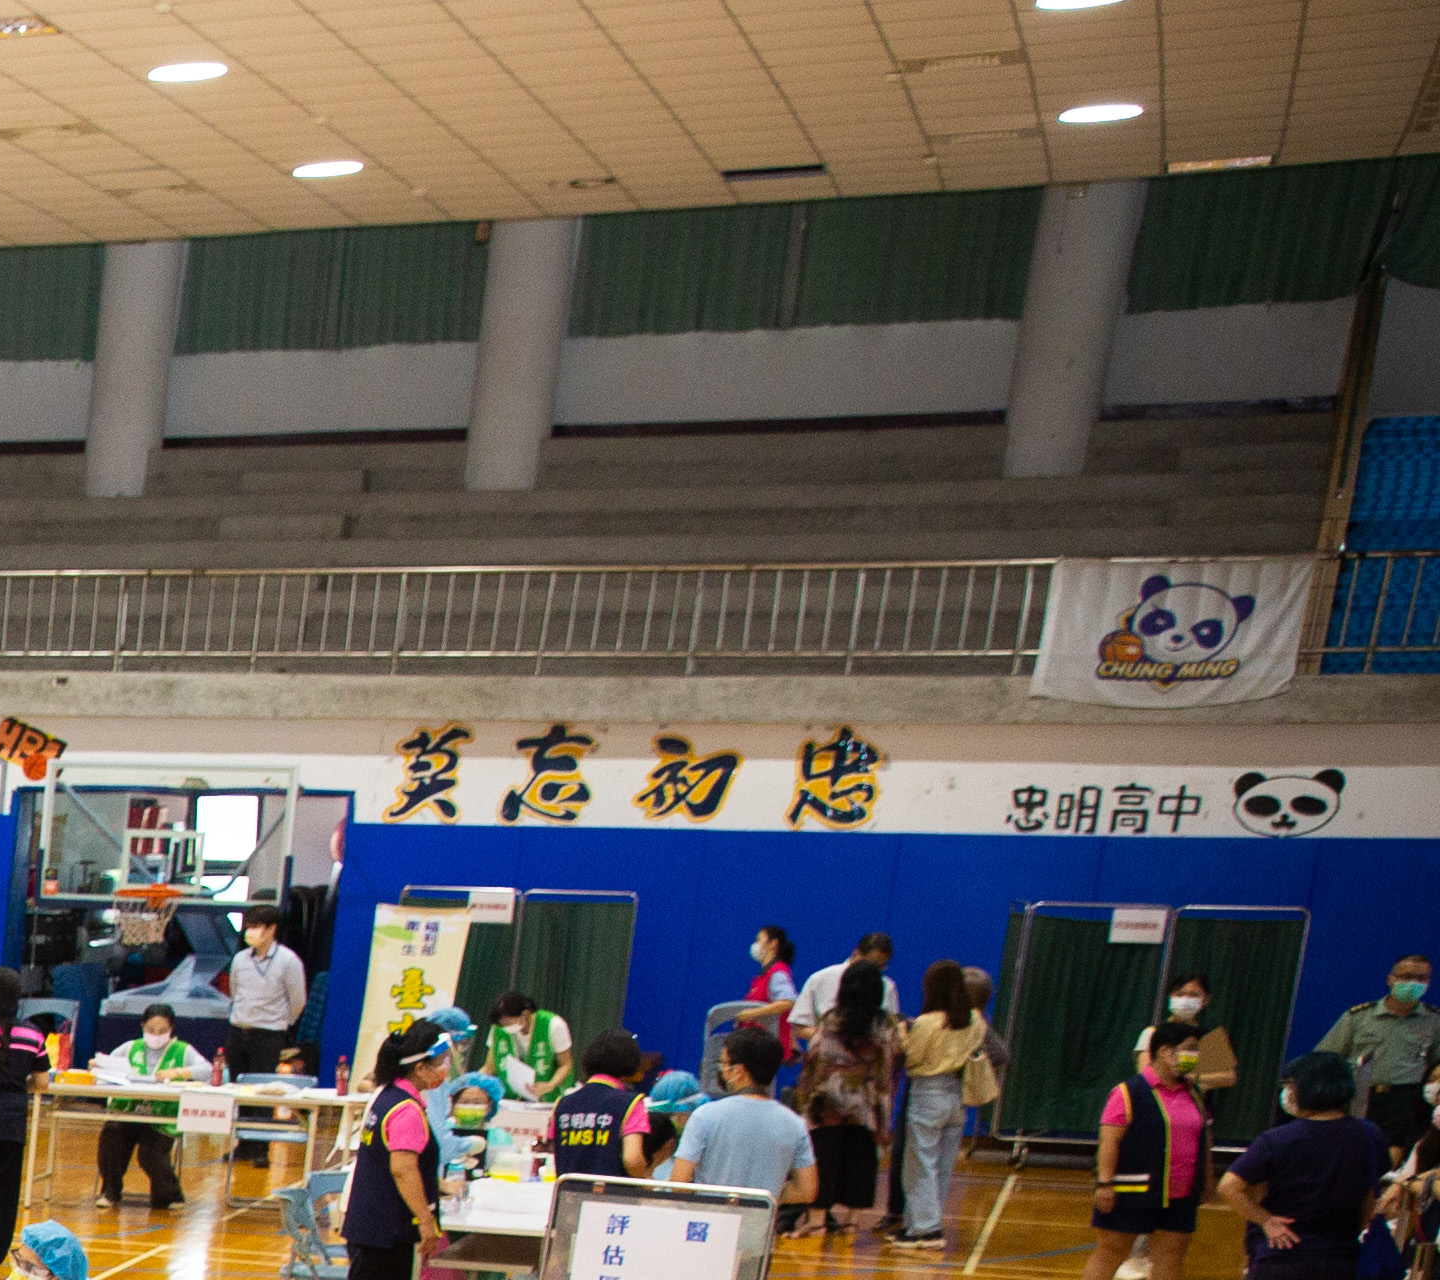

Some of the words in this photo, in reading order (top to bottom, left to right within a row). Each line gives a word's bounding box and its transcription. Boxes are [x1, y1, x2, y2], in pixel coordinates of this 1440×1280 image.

[1097, 659, 1173, 680] CHUNG
[1176, 657, 1240, 680] MING
[1005, 783, 1202, 834] 忠明高中
